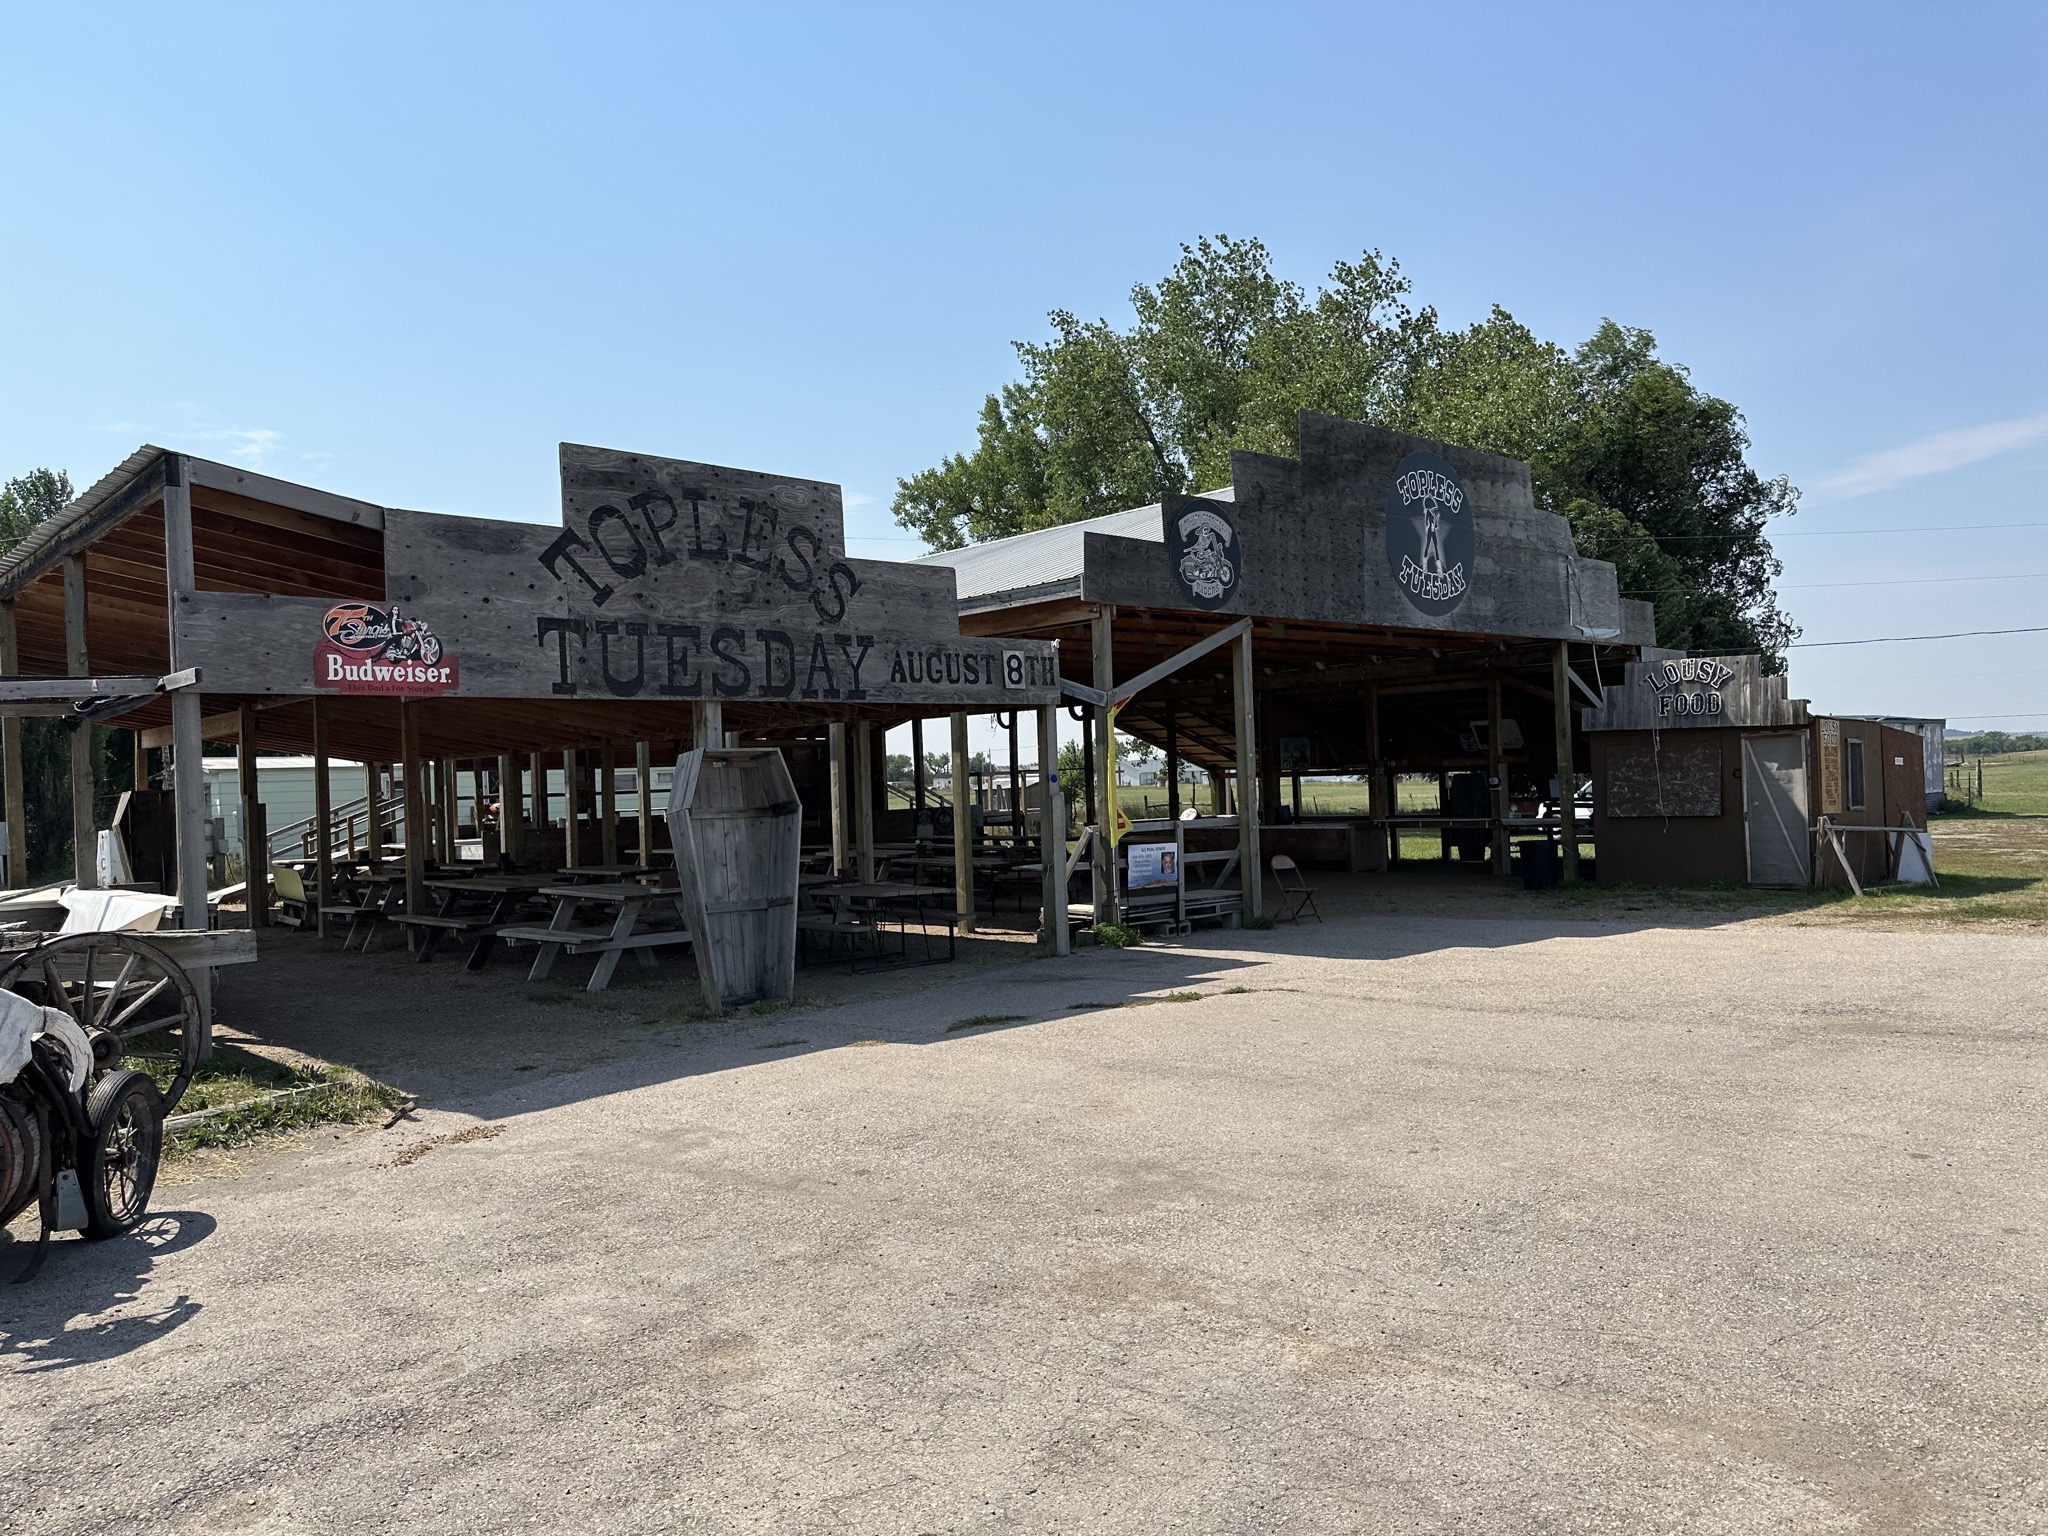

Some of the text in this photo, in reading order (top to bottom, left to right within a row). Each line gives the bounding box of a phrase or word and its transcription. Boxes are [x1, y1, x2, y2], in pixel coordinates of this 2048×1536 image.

[1397, 470, 1464, 513] TOPLESS
[538, 486, 861, 625] TOPLESS
[1399, 555, 1466, 600] TUESDAY
[340, 622, 391, 640] Sturgis
[537, 616, 874, 699] TUESDAY
[891, 650, 997, 685] AUGUST
[1645, 658, 1733, 694] LOUSY
[367, 684, 390, 692] Bud's
[407, 685, 434, 693] Sturgis
[1658, 691, 1721, 717] FOOD
